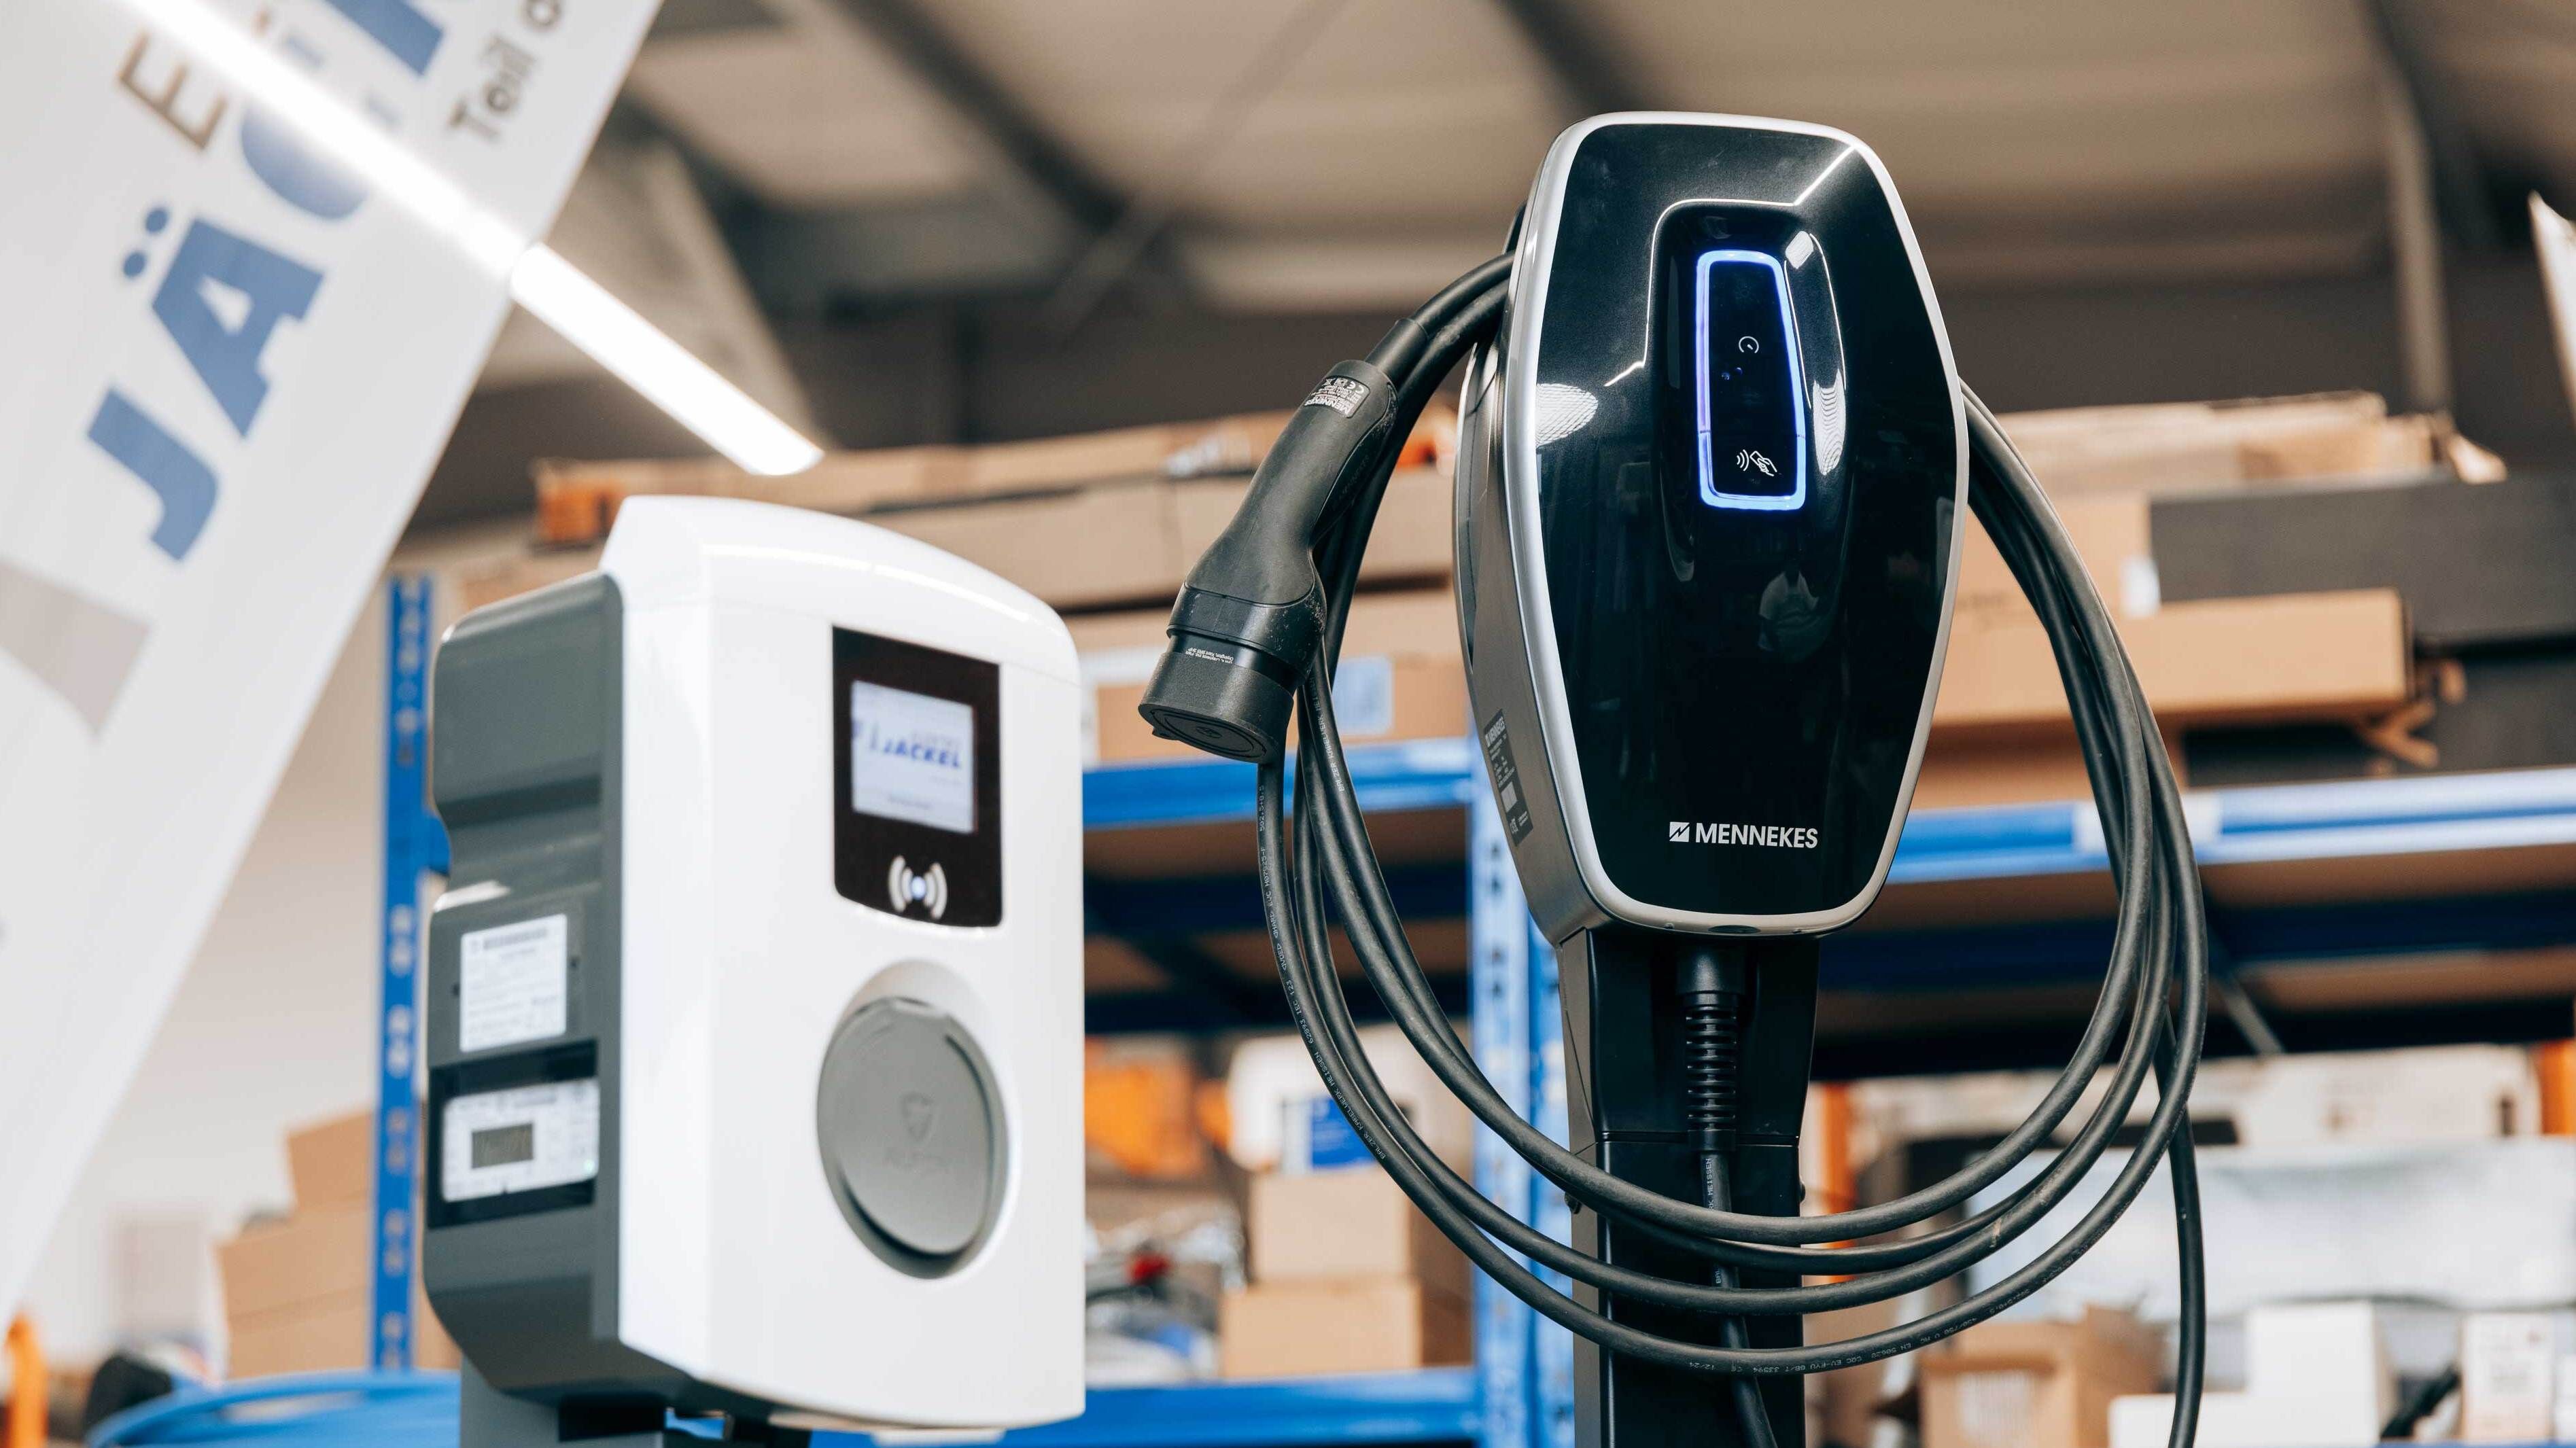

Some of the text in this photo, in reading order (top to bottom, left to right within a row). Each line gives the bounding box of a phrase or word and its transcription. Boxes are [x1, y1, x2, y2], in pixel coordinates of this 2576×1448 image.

[1695, 822, 1819, 849] MENNEKES
[1285, 978, 1295, 995] 123
[1291, 998, 1302, 1014] IEC
[1313, 1050, 1336, 1087] MEISSEN
[1332, 1087, 1364, 1130] KABELWERK
[1362, 1131, 1387, 1160] BALZER
[1705, 1157, 1713, 1195] MEISSEN
